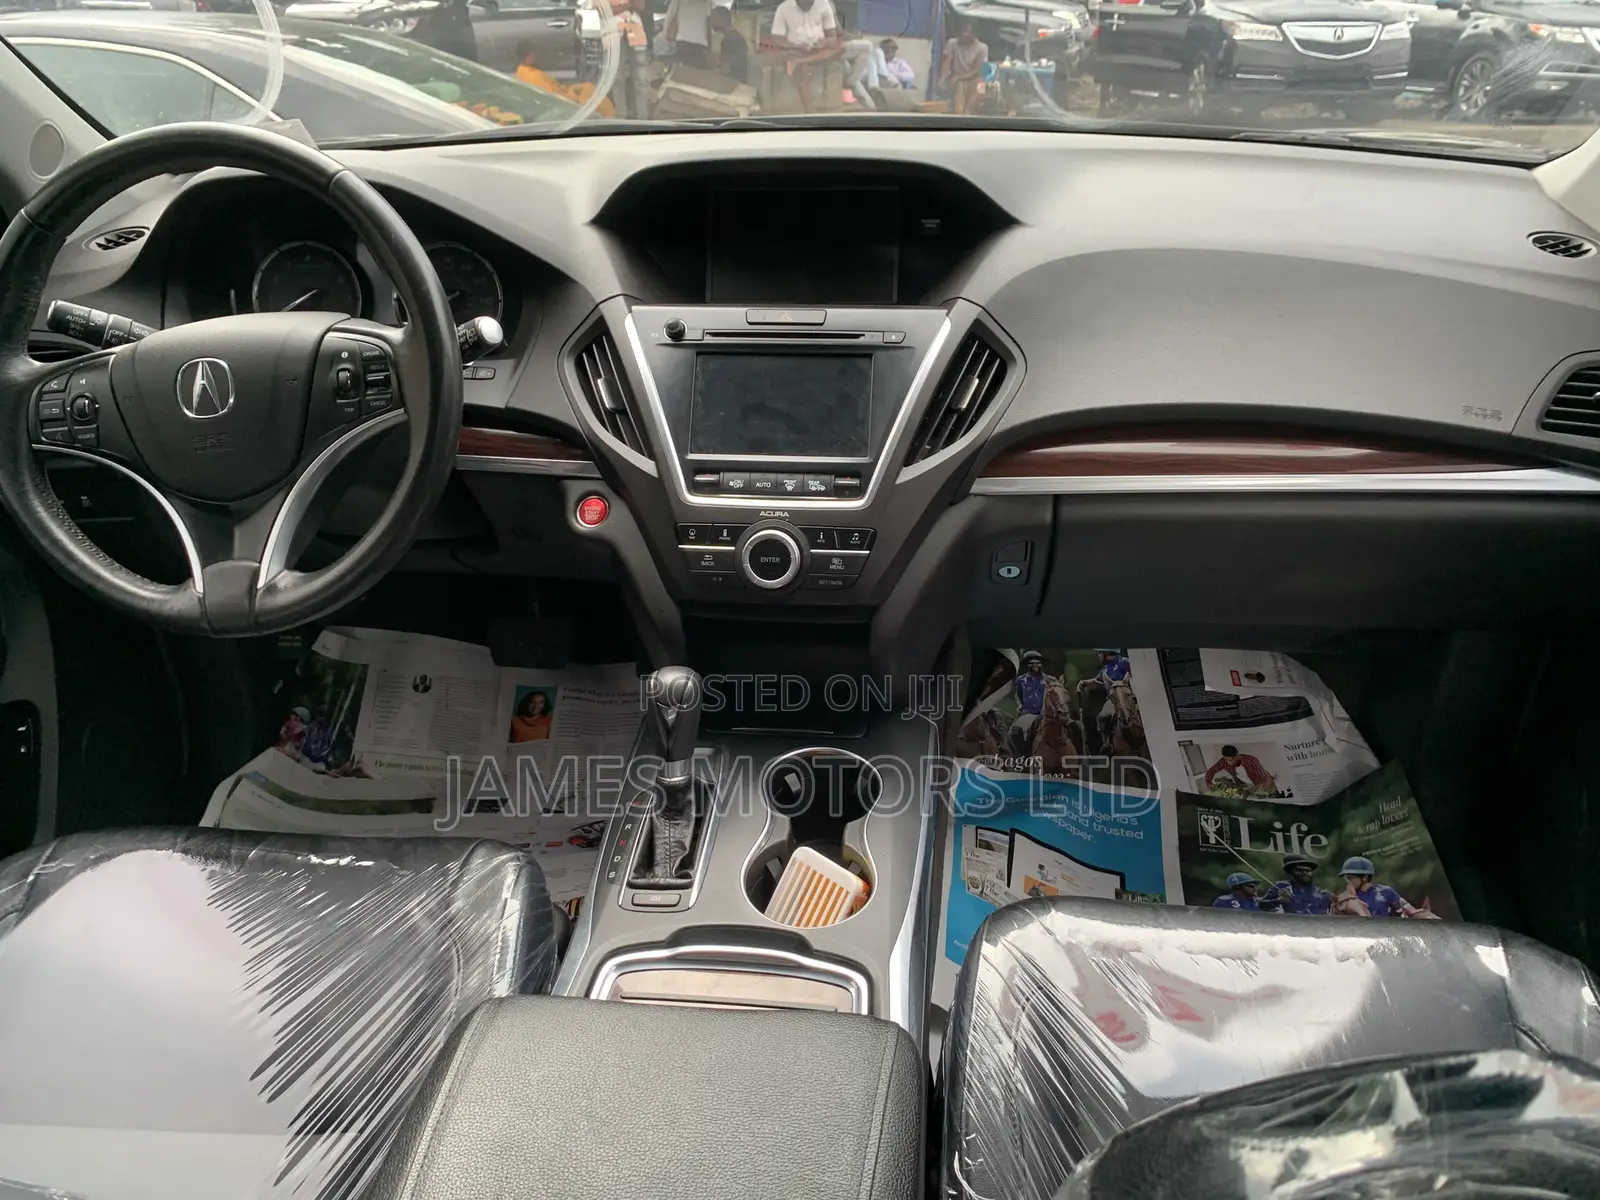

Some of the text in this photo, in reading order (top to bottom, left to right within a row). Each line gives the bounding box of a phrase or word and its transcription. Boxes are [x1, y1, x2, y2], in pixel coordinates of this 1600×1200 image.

[66, 314, 83, 324] AUTO
[1283, 738, 1321, 751] Nurture
[993, 752, 1043, 772] Lagos
[1286, 751, 1309, 762] with
[1066, 809, 1144, 840] and trusted
[1083, 803, 1139, 826] Nigeria's
[1229, 814, 1330, 860] Life
